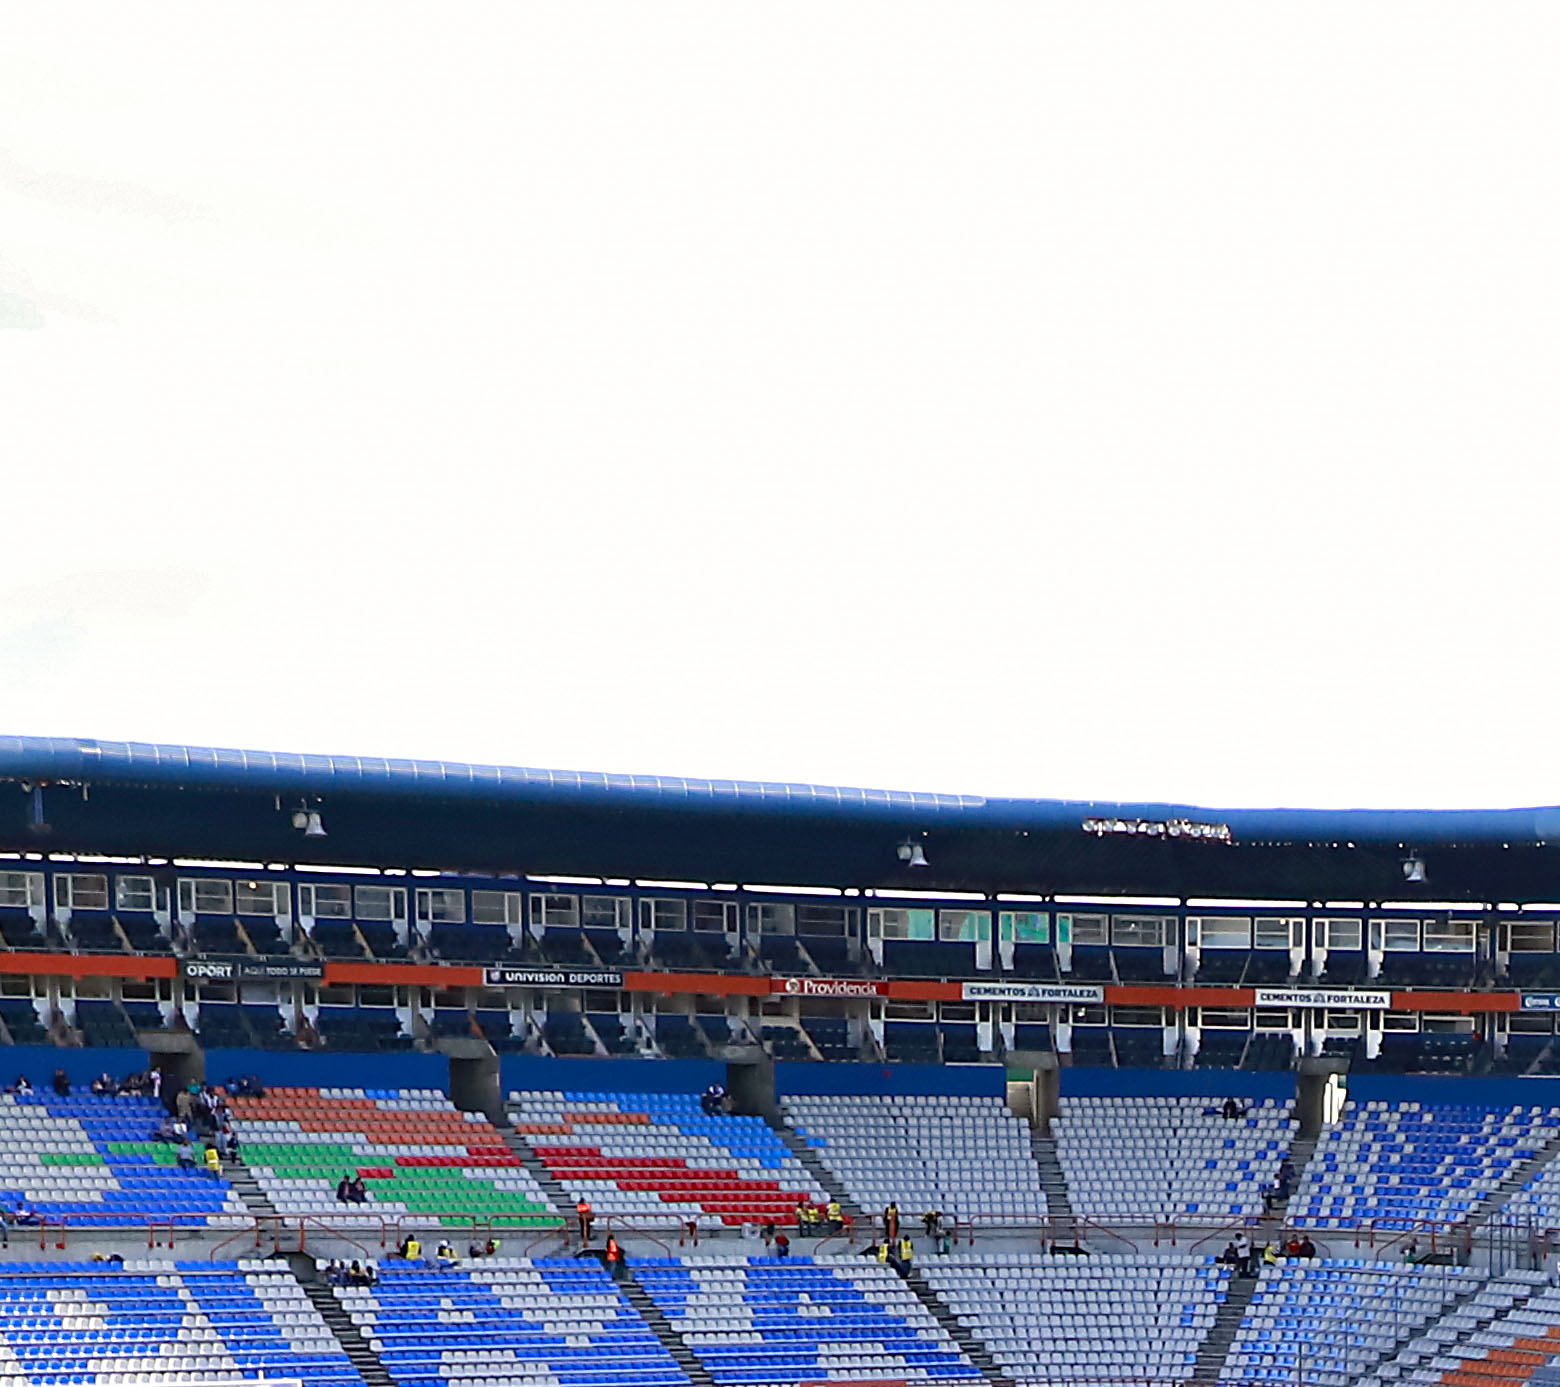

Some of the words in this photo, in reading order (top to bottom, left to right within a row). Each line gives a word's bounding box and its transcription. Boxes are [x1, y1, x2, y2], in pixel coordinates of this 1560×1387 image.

[569, 973, 622, 984] DEPORTES
[804, 980, 877, 995] Providencia
[970, 987, 1026, 996] CEMENTOS
[1042, 989, 1098, 998] FORTALEZA
[1260, 993, 1312, 1003] CEMENTOS
[1327, 995, 1386, 1004] FORTALEZA
